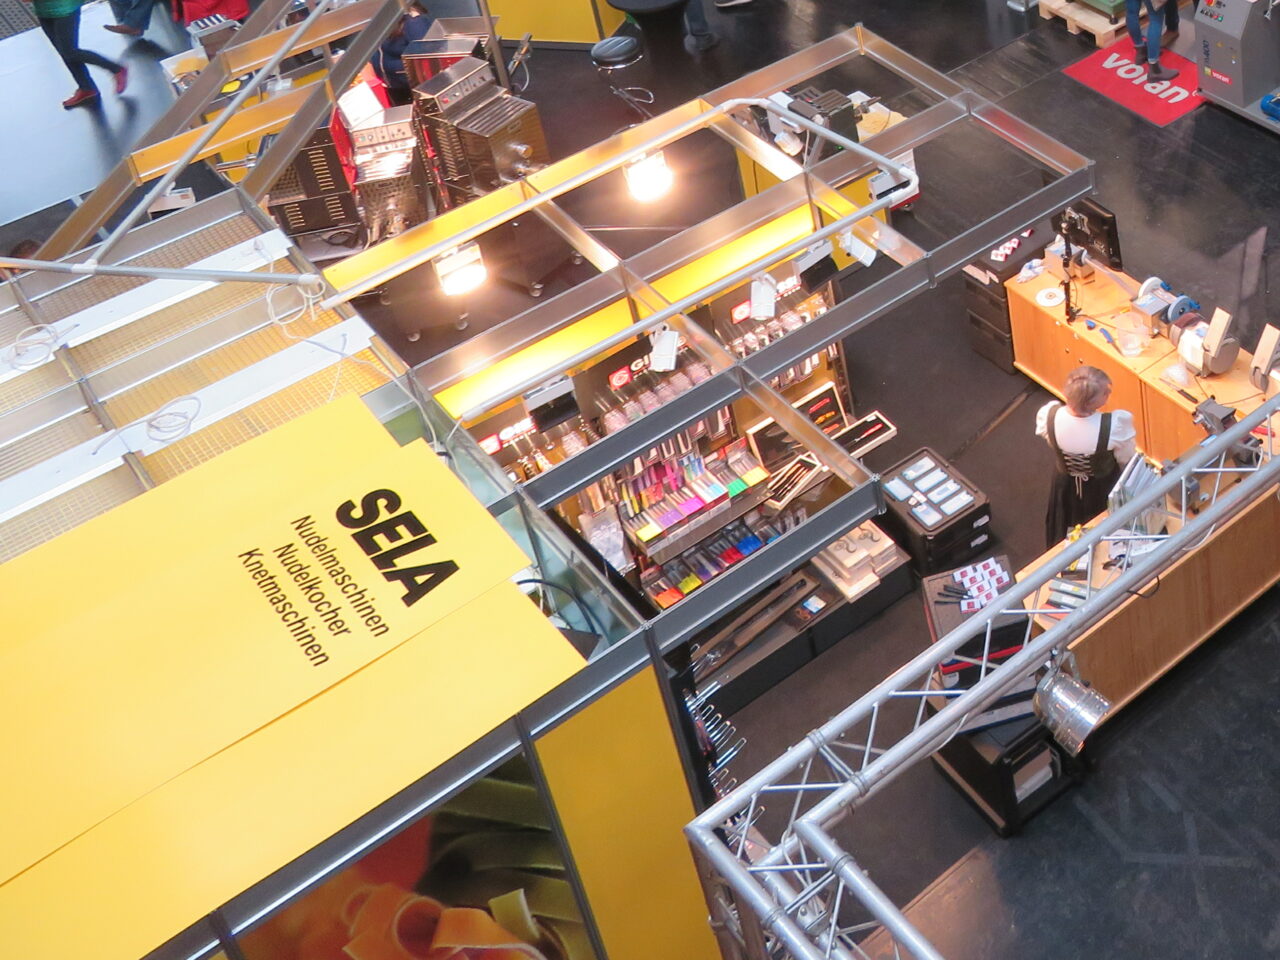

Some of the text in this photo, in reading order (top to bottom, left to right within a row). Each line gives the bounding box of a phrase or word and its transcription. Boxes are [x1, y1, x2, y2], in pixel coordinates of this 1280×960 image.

[1102, 52, 1189, 104] voran
[273, 542, 352, 638] Nudelkocher
[290, 514, 390, 638] Nudelmaschinen
[335, 488, 460, 607] SELA
[237, 547, 330, 668] Knetmaschinen
